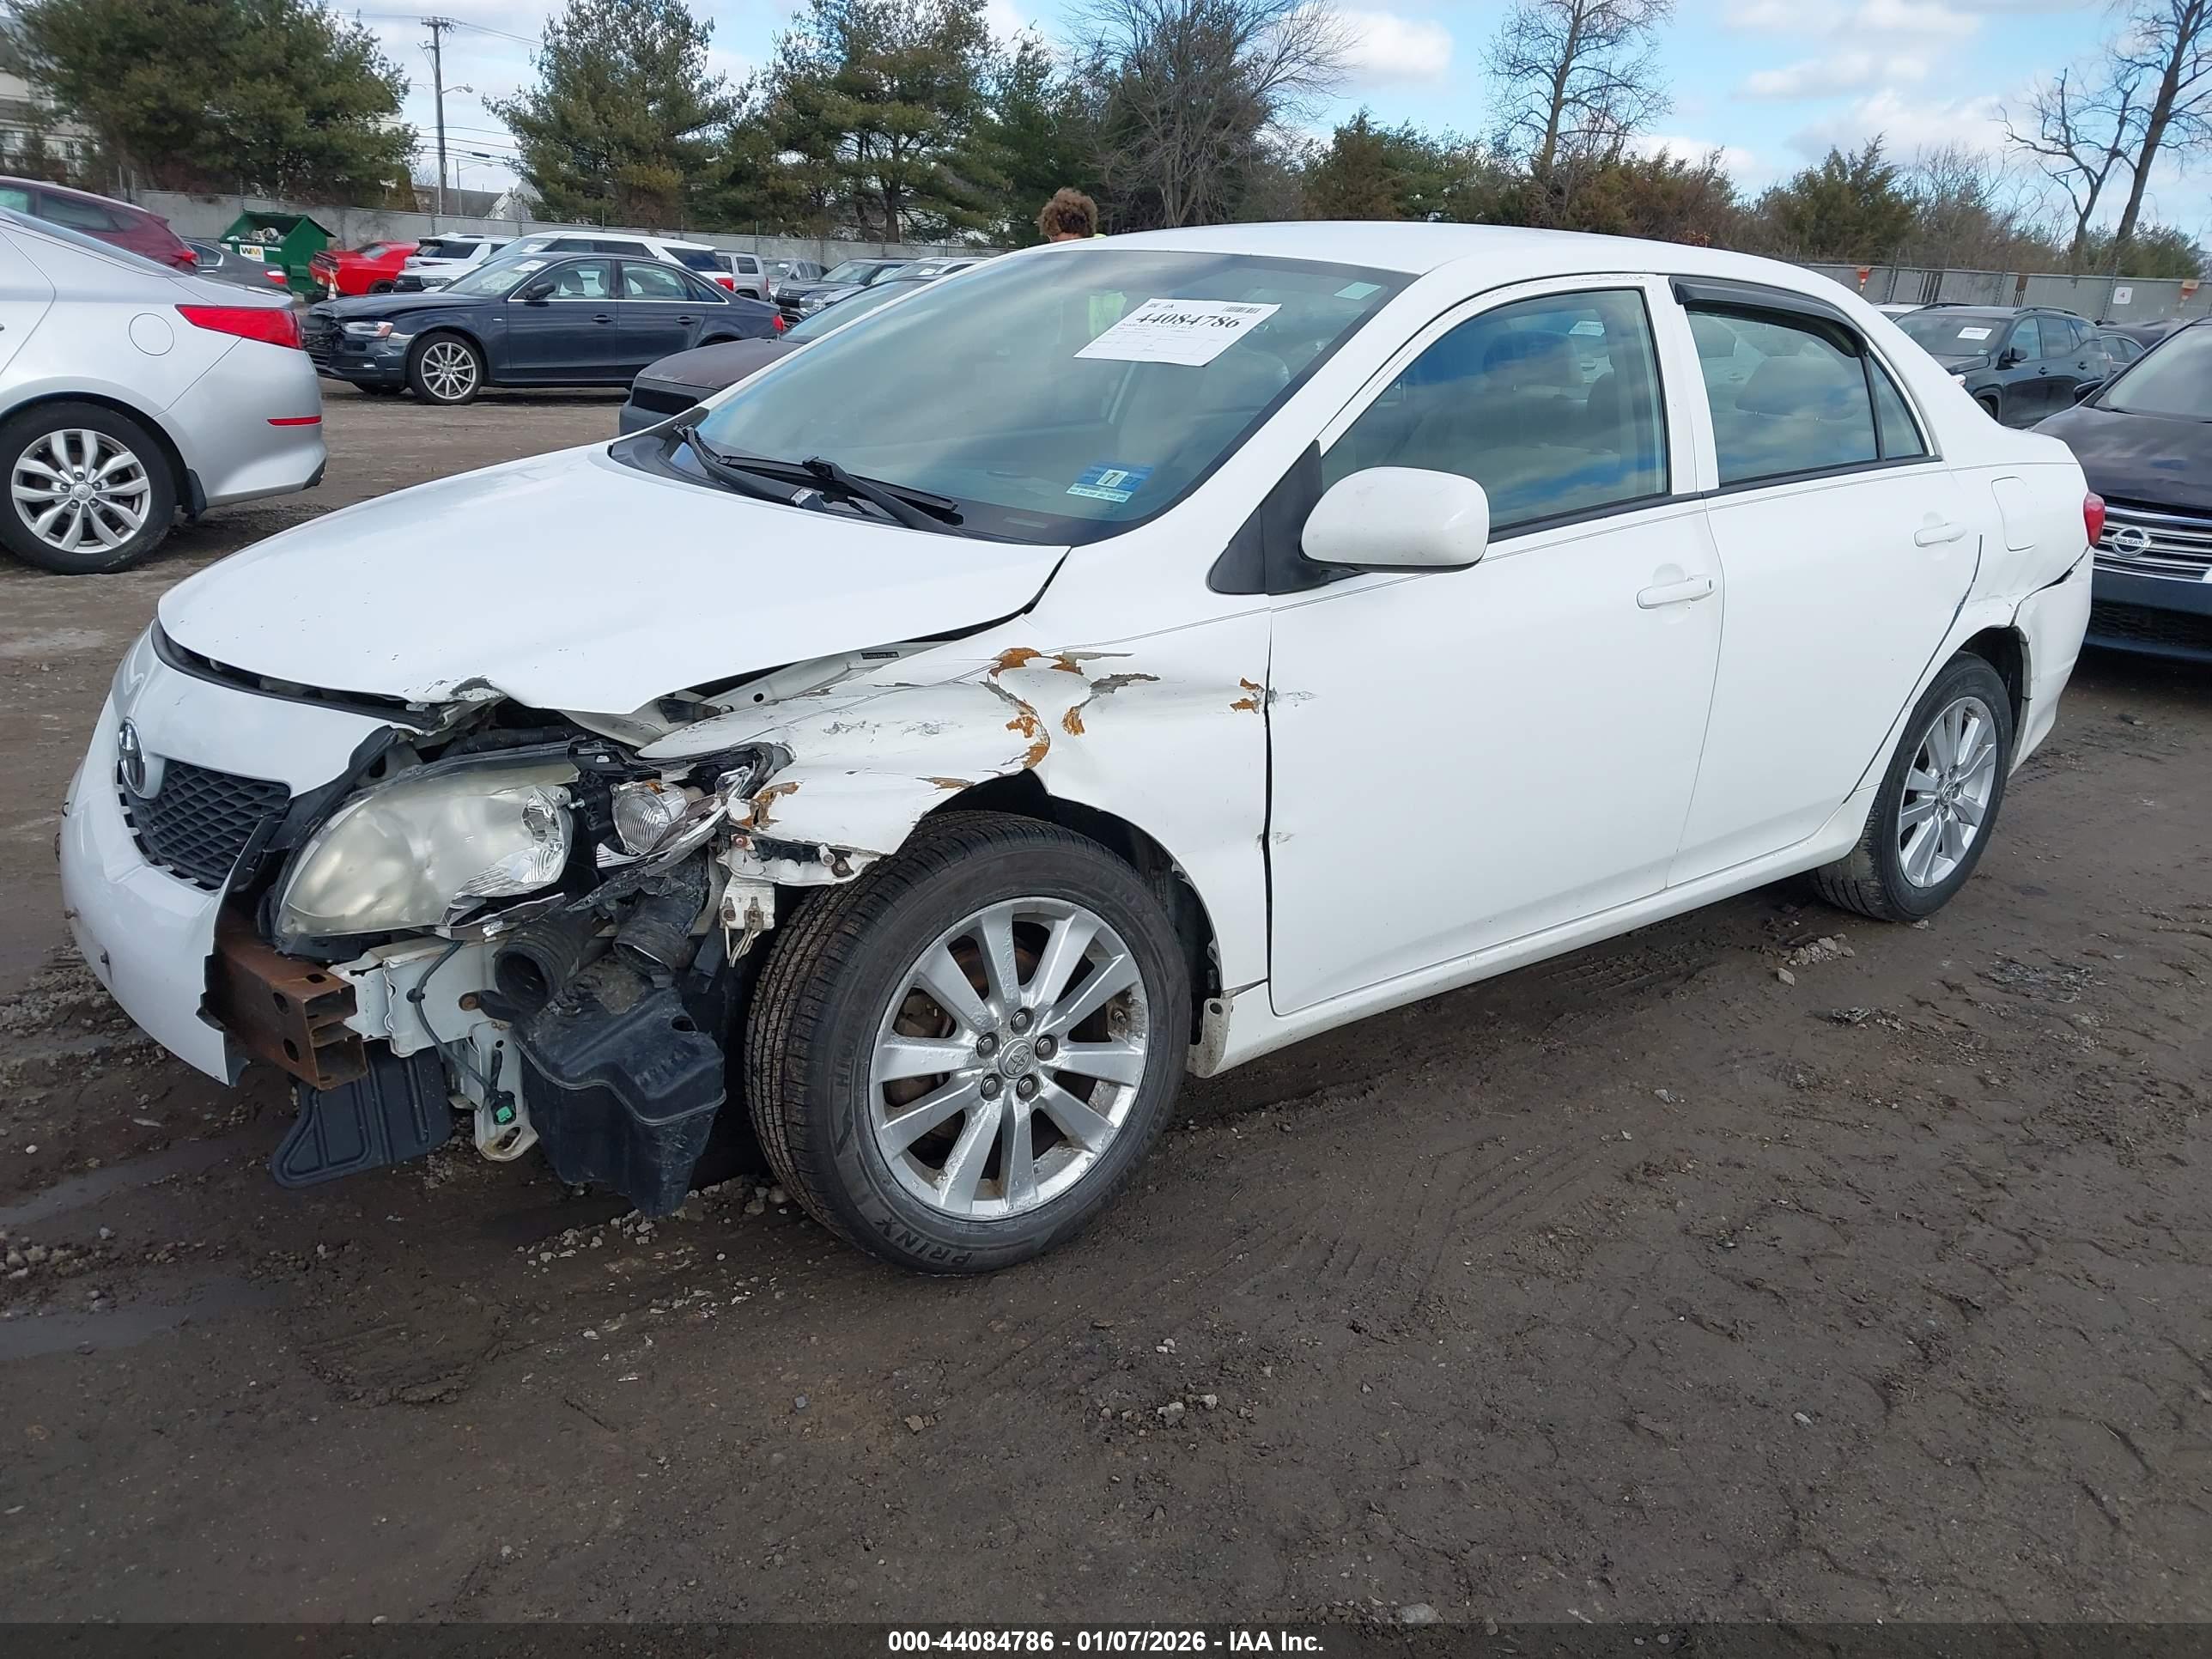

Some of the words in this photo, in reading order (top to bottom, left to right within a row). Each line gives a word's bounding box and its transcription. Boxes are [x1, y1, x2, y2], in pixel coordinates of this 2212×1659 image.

[241, 246, 261, 255] WM
[1136, 312, 1247, 329] 44084786
[2114, 537, 2145, 547] NISSAN
[874, 1216, 973, 1264] PRINX
